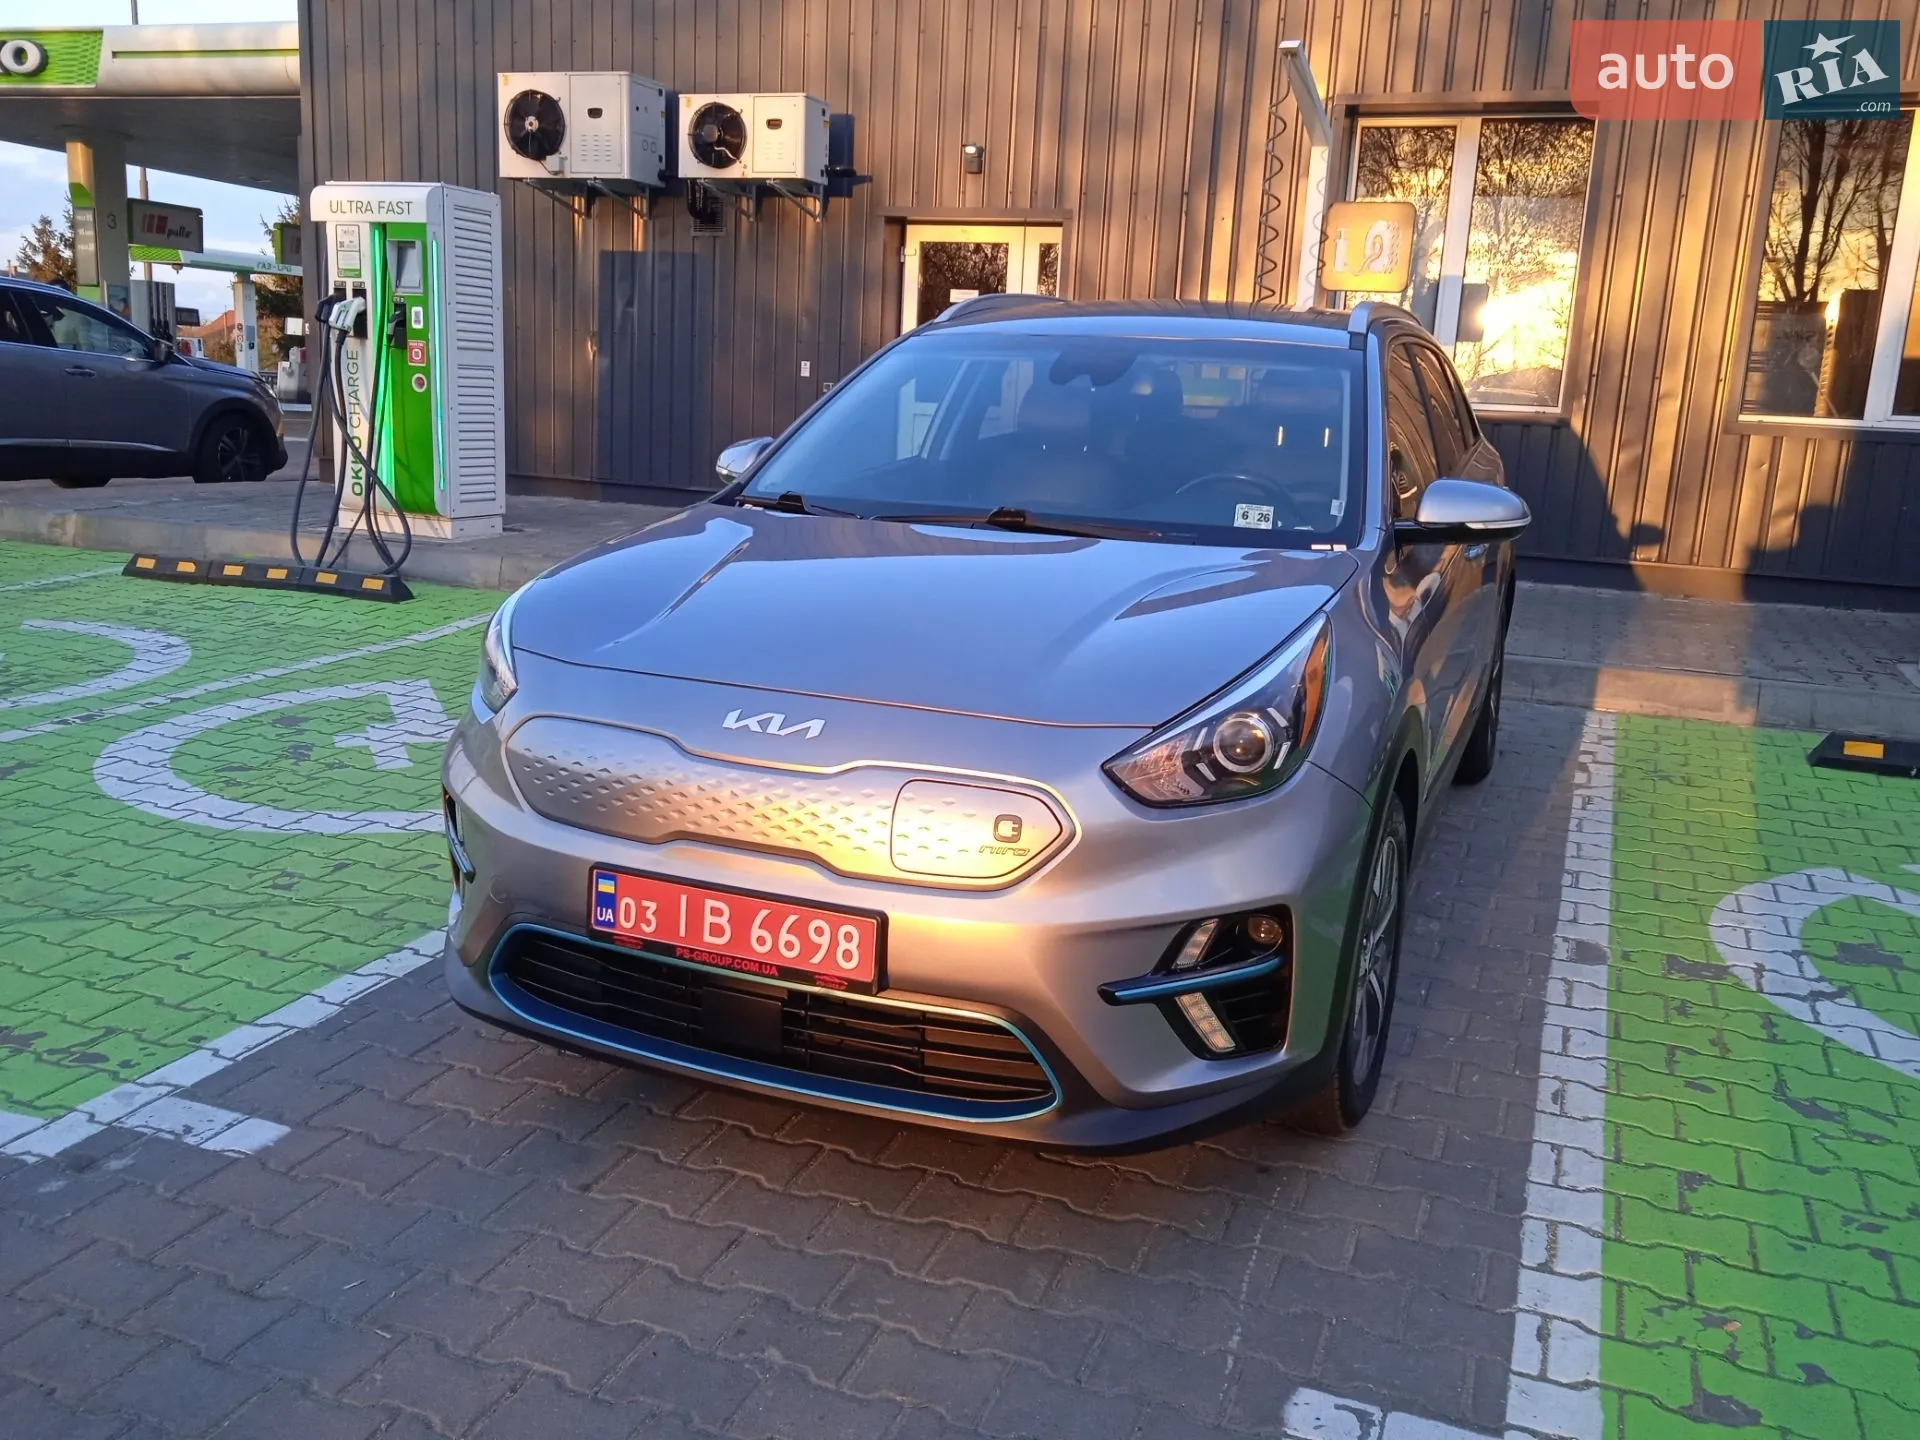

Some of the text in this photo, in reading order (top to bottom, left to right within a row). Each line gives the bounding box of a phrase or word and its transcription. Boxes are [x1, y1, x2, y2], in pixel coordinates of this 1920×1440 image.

[0, 39, 45, 75] O
[329, 200, 413, 215] ULTRA FAST
[106, 213, 117, 229] 3
[346, 350, 361, 429] CHARGE
[1241, 510, 1271, 522] 6 26
[596, 907, 614, 922] UA
[619, 893, 861, 970] 03 IB 6698
[675, 947, 780, 977] PS-GROUP.COM.UA
